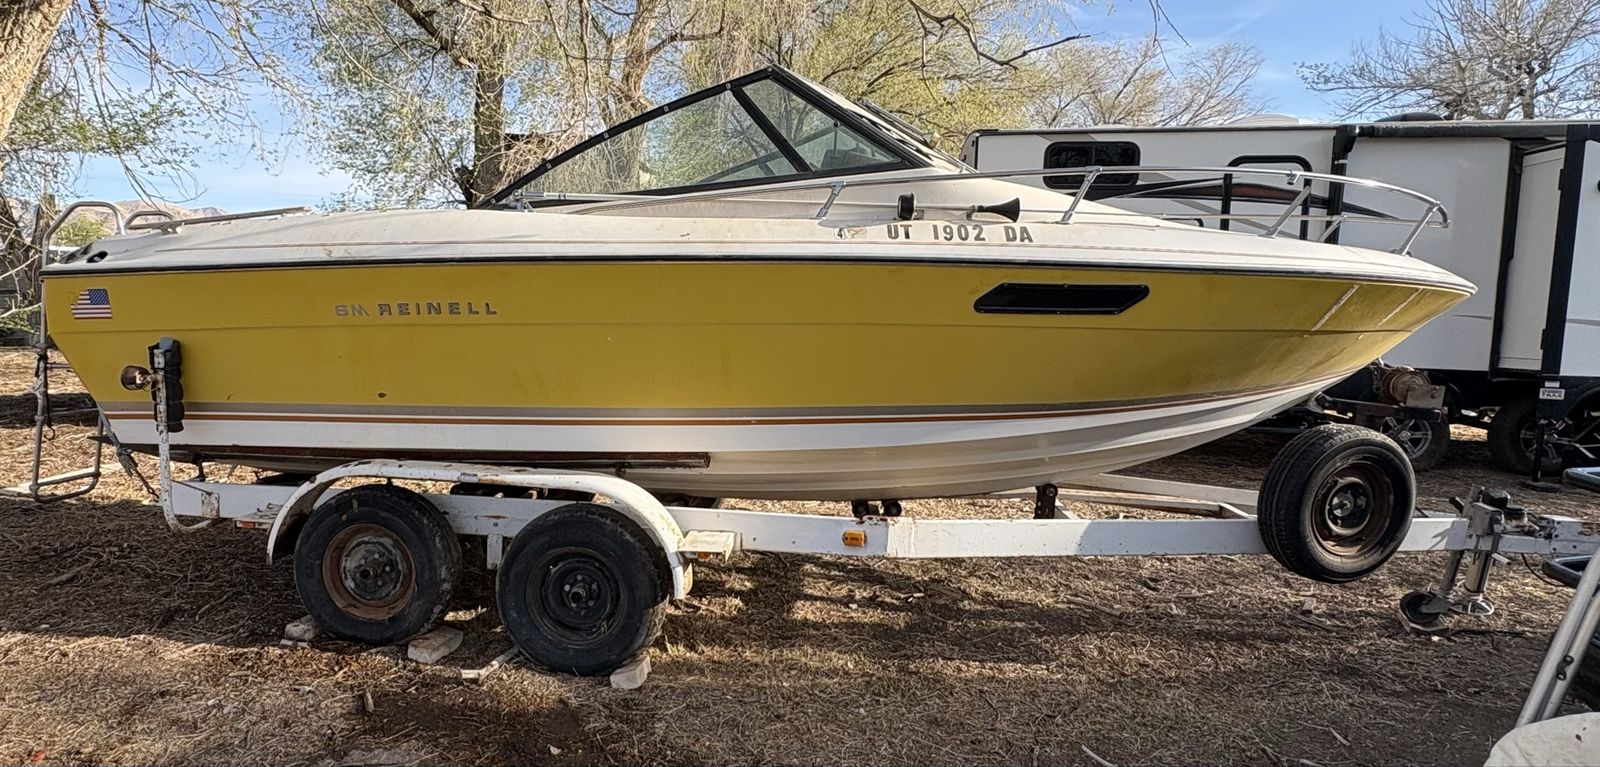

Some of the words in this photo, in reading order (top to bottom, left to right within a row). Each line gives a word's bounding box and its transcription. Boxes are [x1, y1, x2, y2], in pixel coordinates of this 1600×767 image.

[887, 224, 912, 240] UT
[933, 224, 986, 241] 1902
[1004, 225, 1033, 242] DA
[378, 303, 497, 315] REINELL
